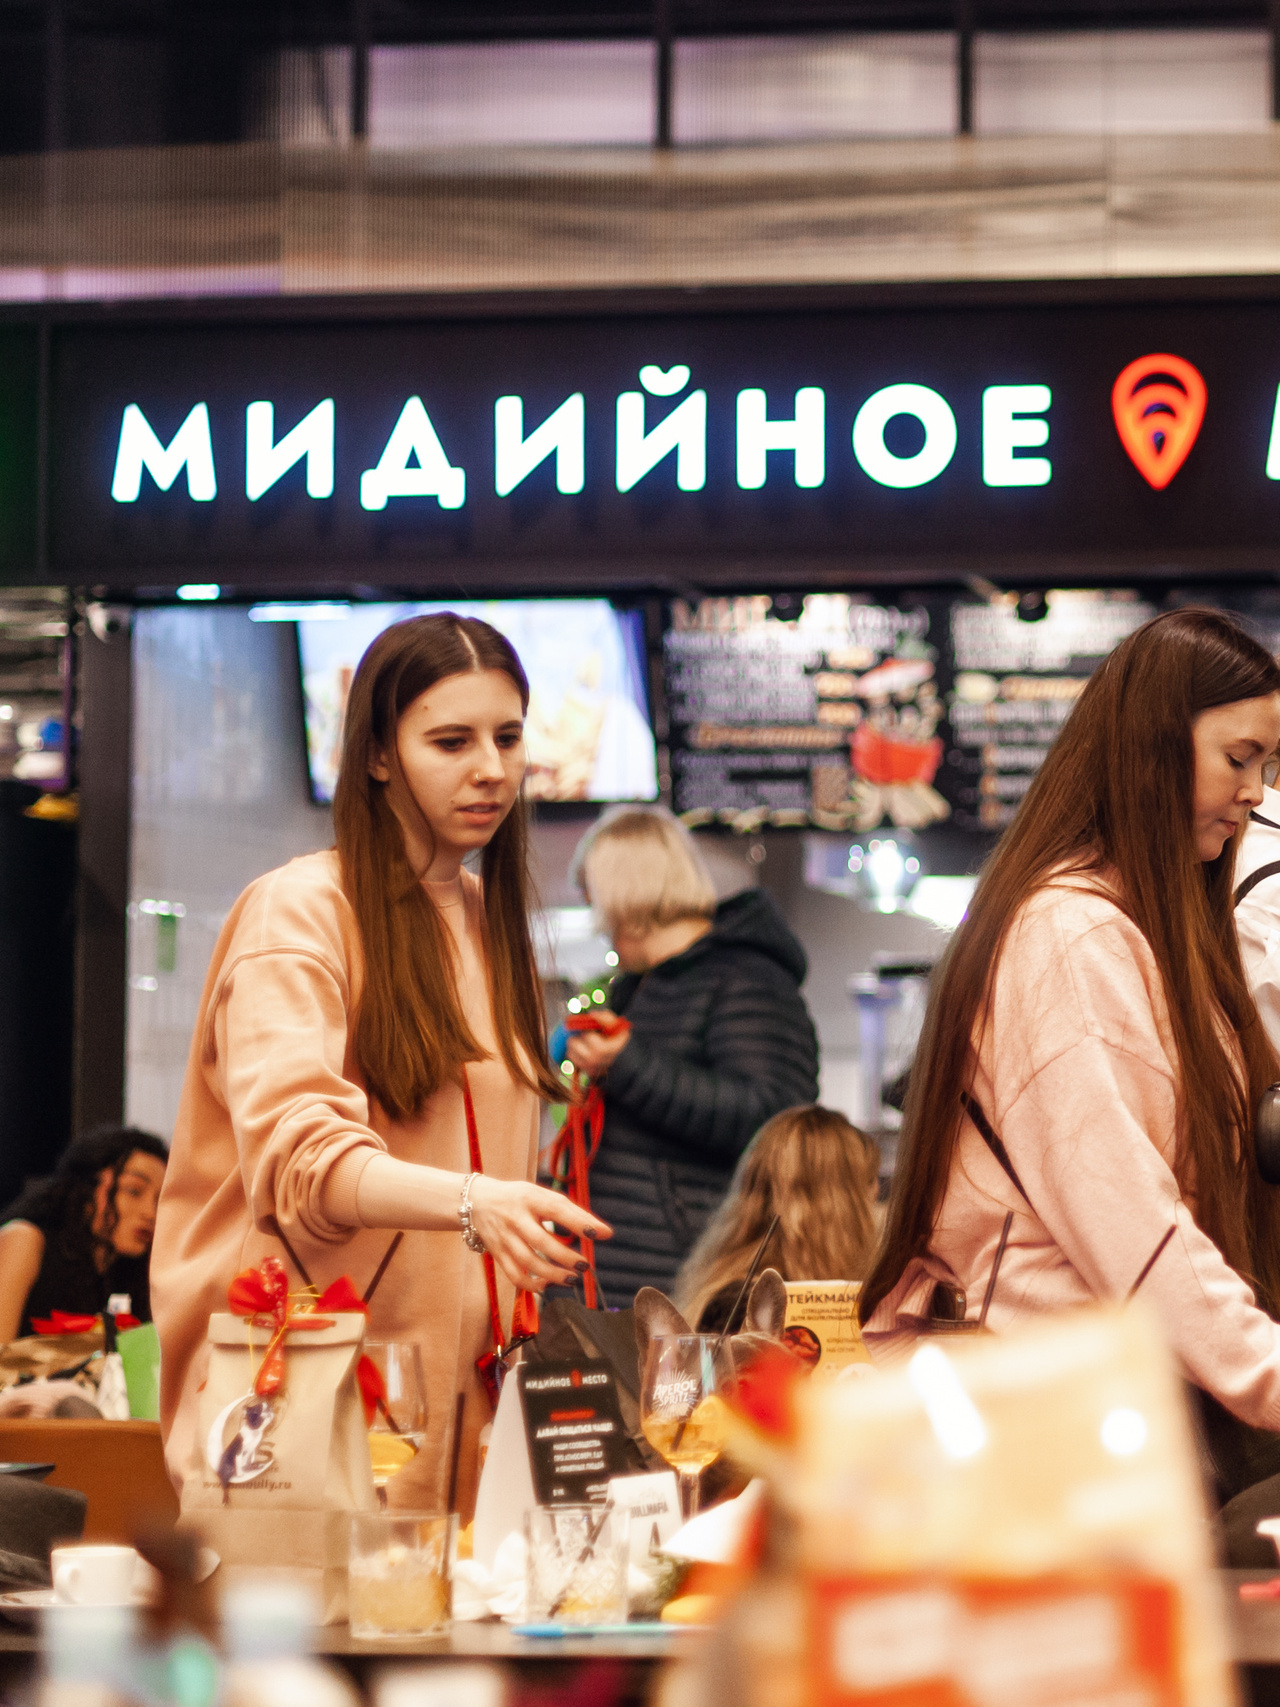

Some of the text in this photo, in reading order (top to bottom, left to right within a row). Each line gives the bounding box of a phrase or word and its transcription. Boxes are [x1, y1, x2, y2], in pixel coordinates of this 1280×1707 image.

[111, 365, 1052, 511] МИДИЙНОЕ
[653, 1379, 697, 1402] APEROL
[658, 1391, 689, 1407] SPRITZ
